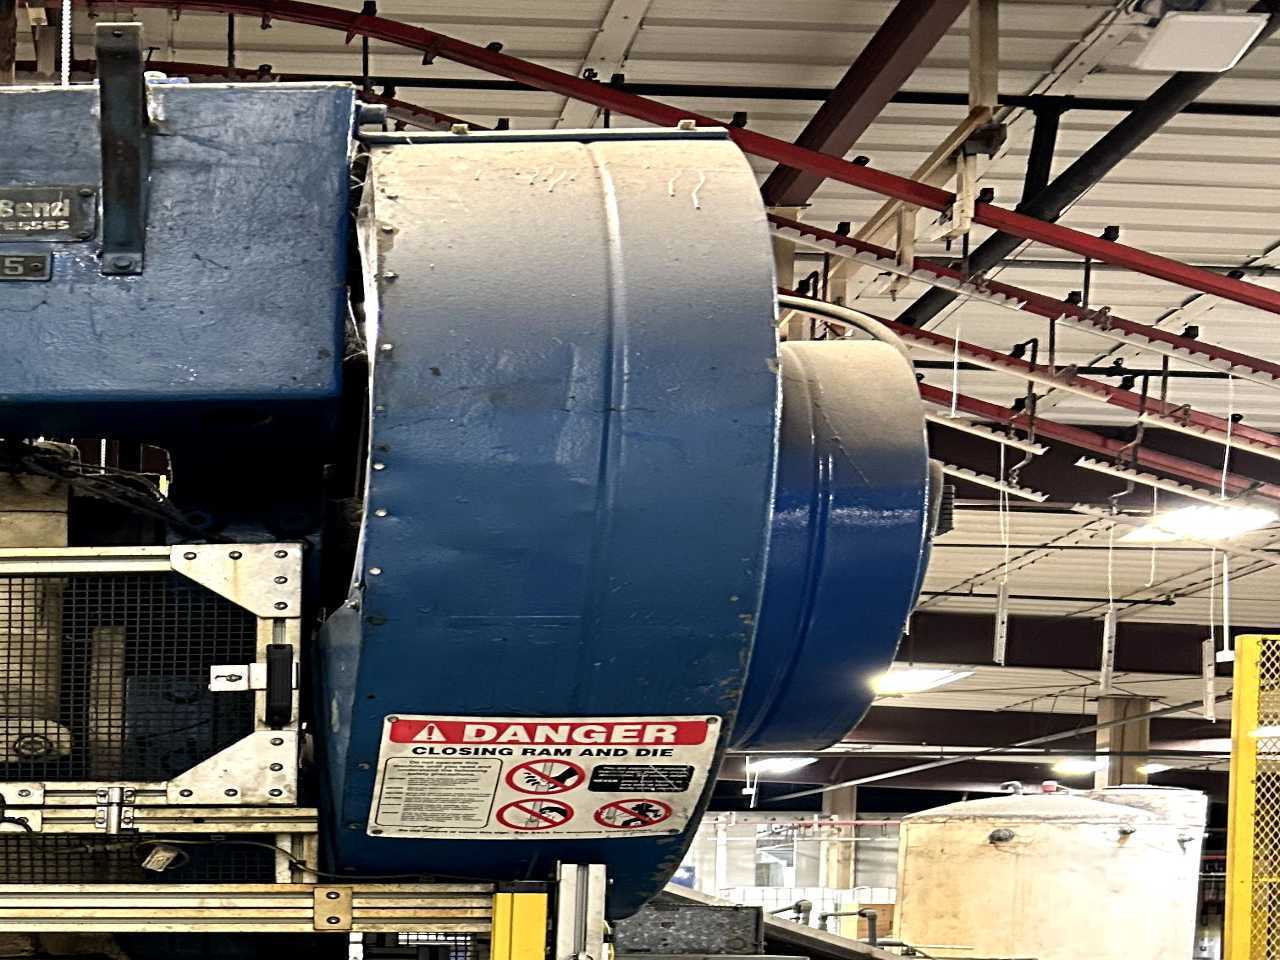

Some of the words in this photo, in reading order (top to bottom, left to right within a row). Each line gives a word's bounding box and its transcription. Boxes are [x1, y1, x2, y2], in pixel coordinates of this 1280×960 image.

[462, 724, 678, 743] DANGER
[412, 746, 513, 757] CLOSING
[521, 748, 572, 757] RAM
[580, 749, 628, 757] AND
[636, 748, 673, 757] DIE
